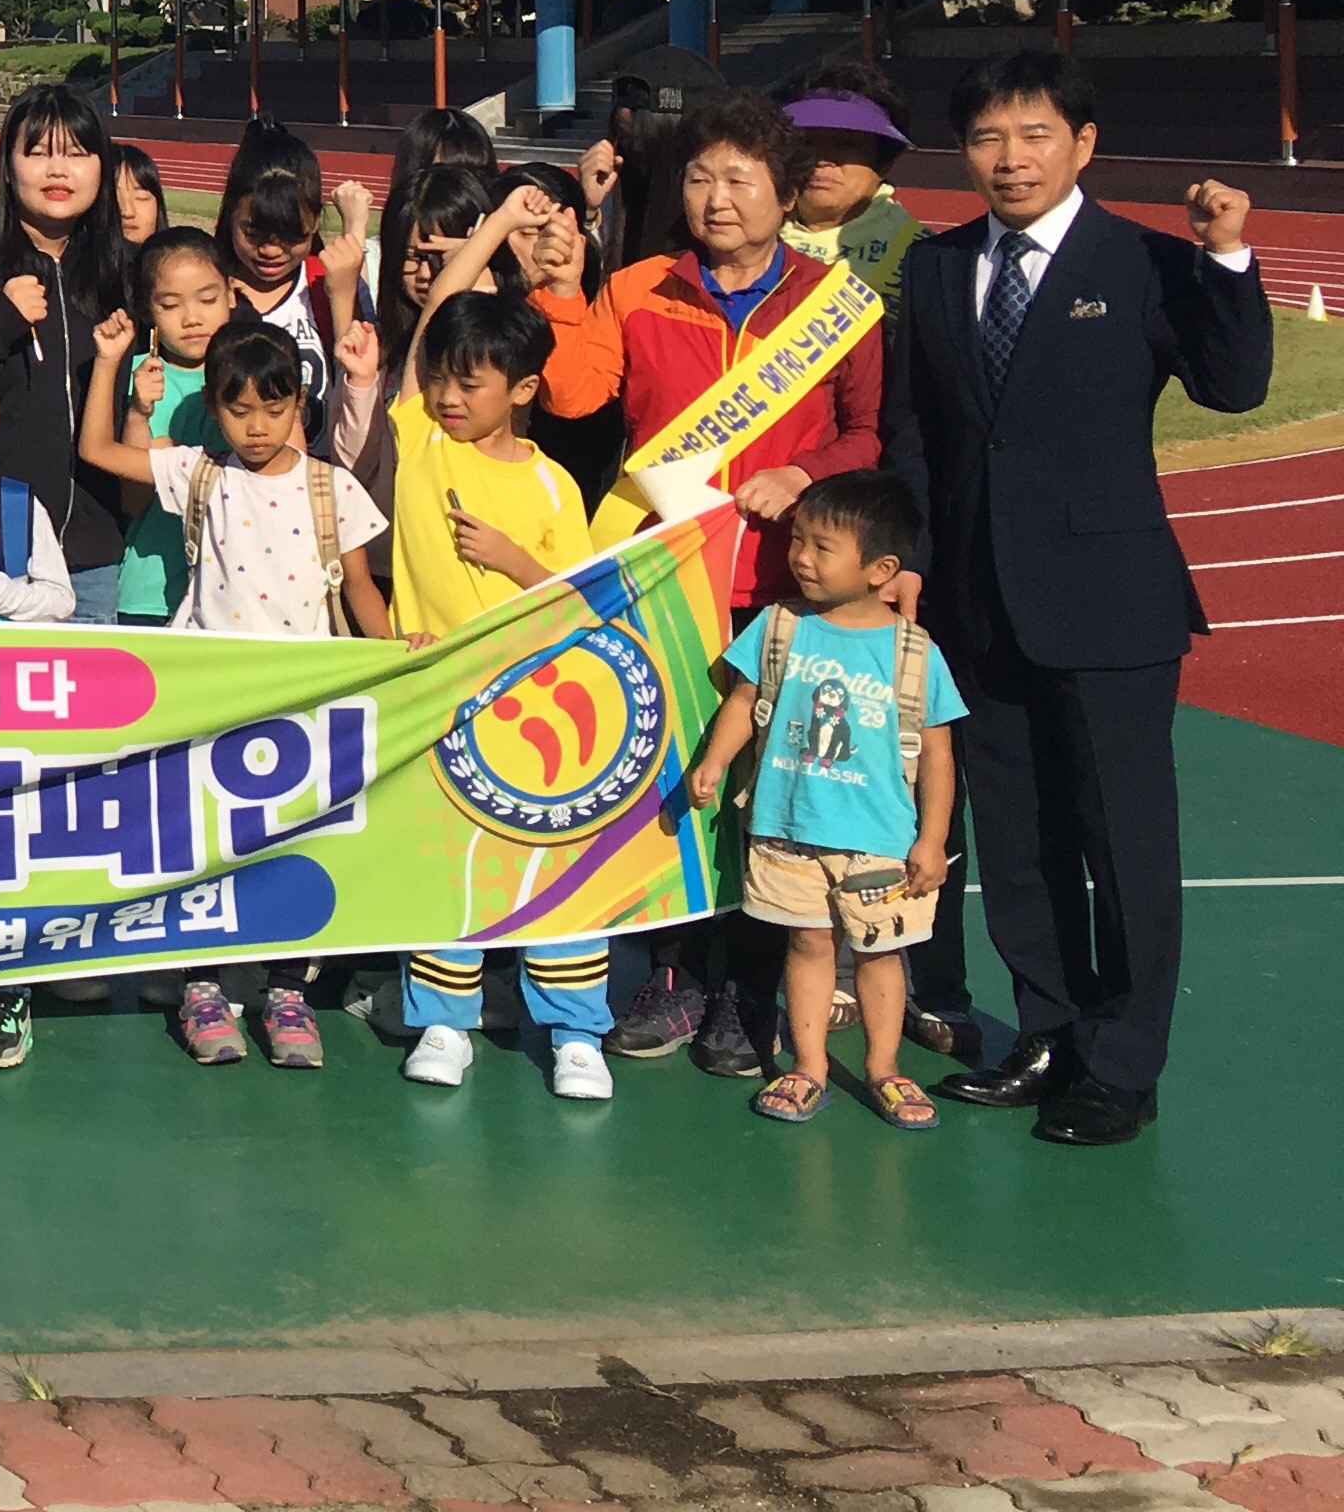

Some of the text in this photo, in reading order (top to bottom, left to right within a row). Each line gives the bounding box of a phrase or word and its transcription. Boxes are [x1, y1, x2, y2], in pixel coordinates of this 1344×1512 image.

[757, 274, 878, 394] 바르게살기운동
[858, 707, 887, 729] 29
[800, 763, 869, 788] CLASSIC
